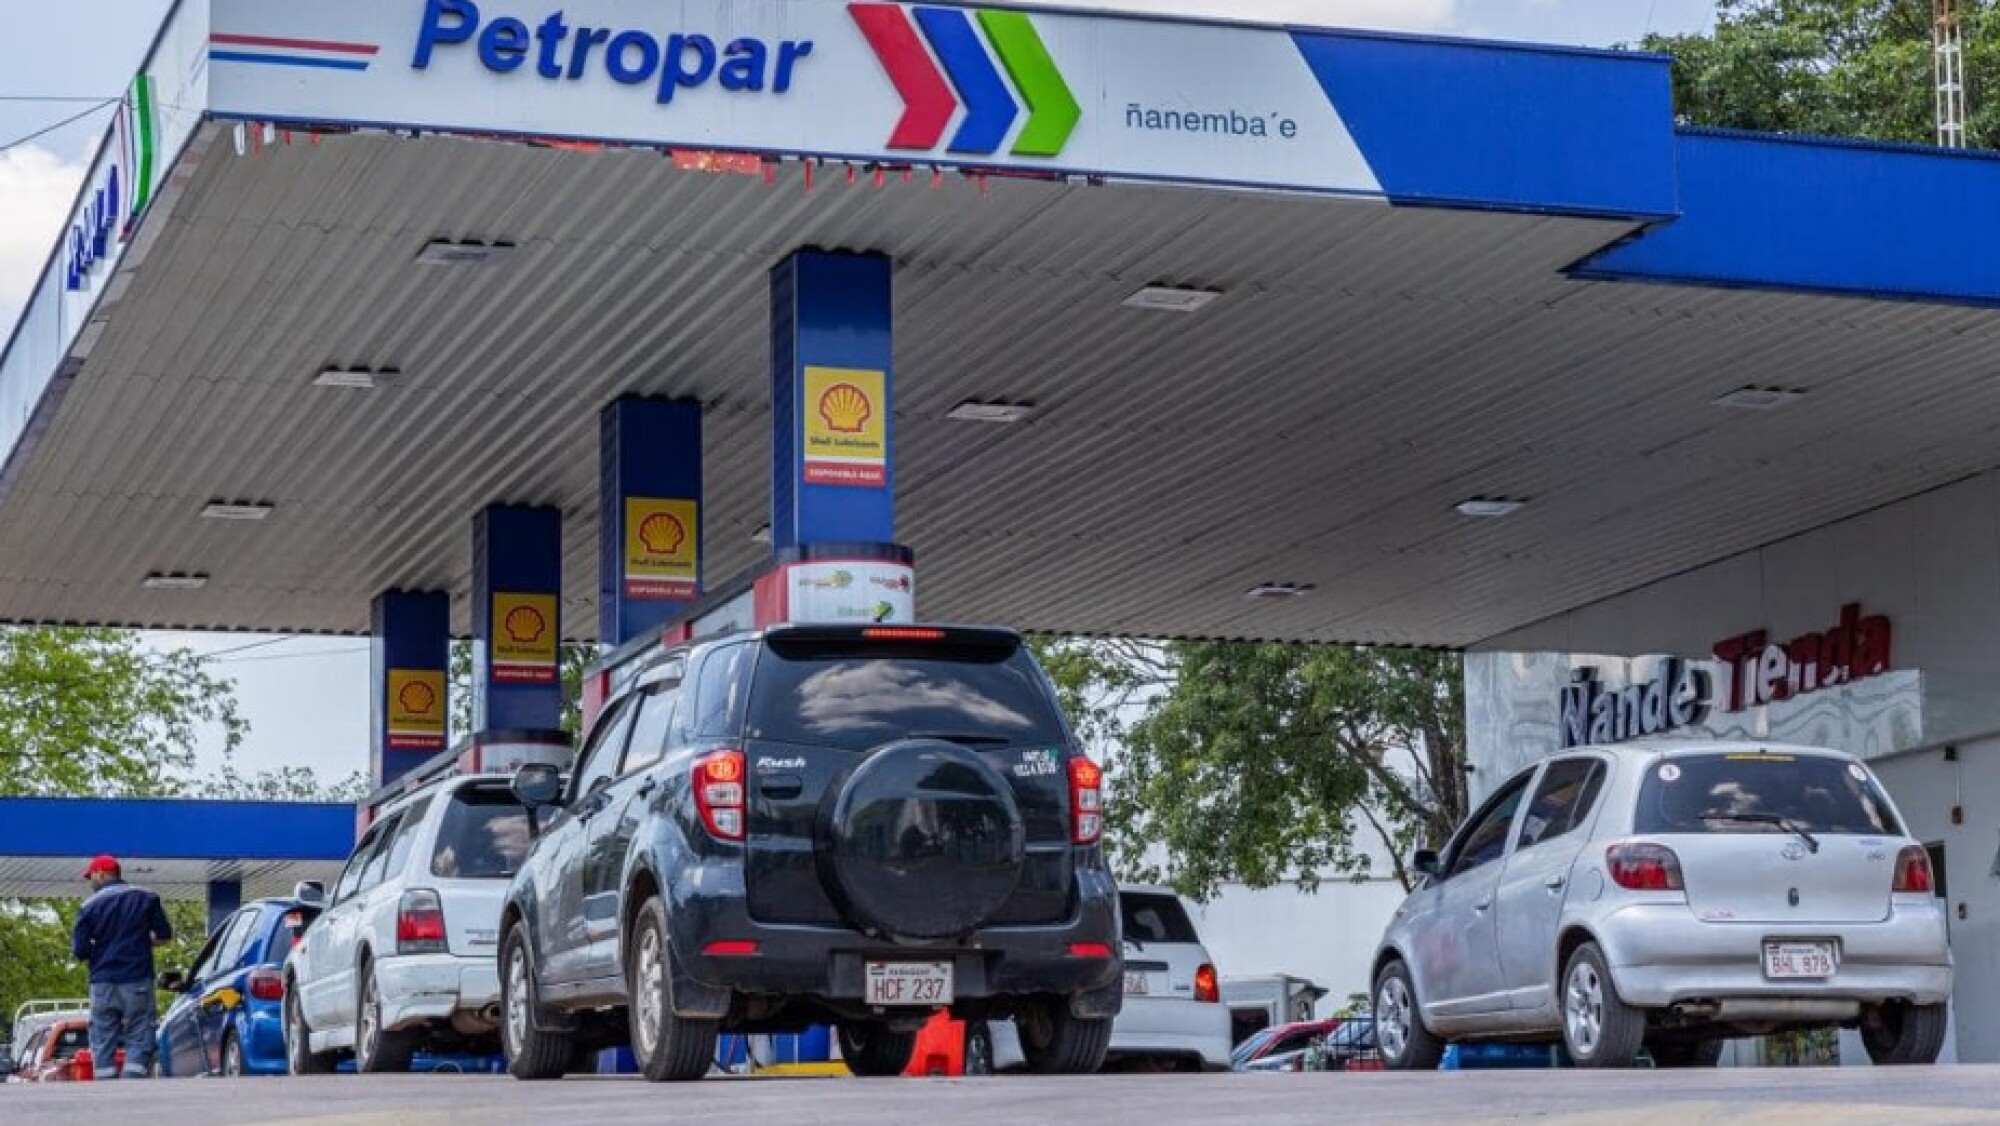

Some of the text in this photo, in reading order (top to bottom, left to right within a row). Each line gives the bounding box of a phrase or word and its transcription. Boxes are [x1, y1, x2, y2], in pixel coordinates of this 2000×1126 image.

[411, 0, 813, 105] Petropar
[1712, 602, 1892, 712] Tienda
[757, 756, 807, 768] Rush
[875, 979, 945, 1000] HCF 237
